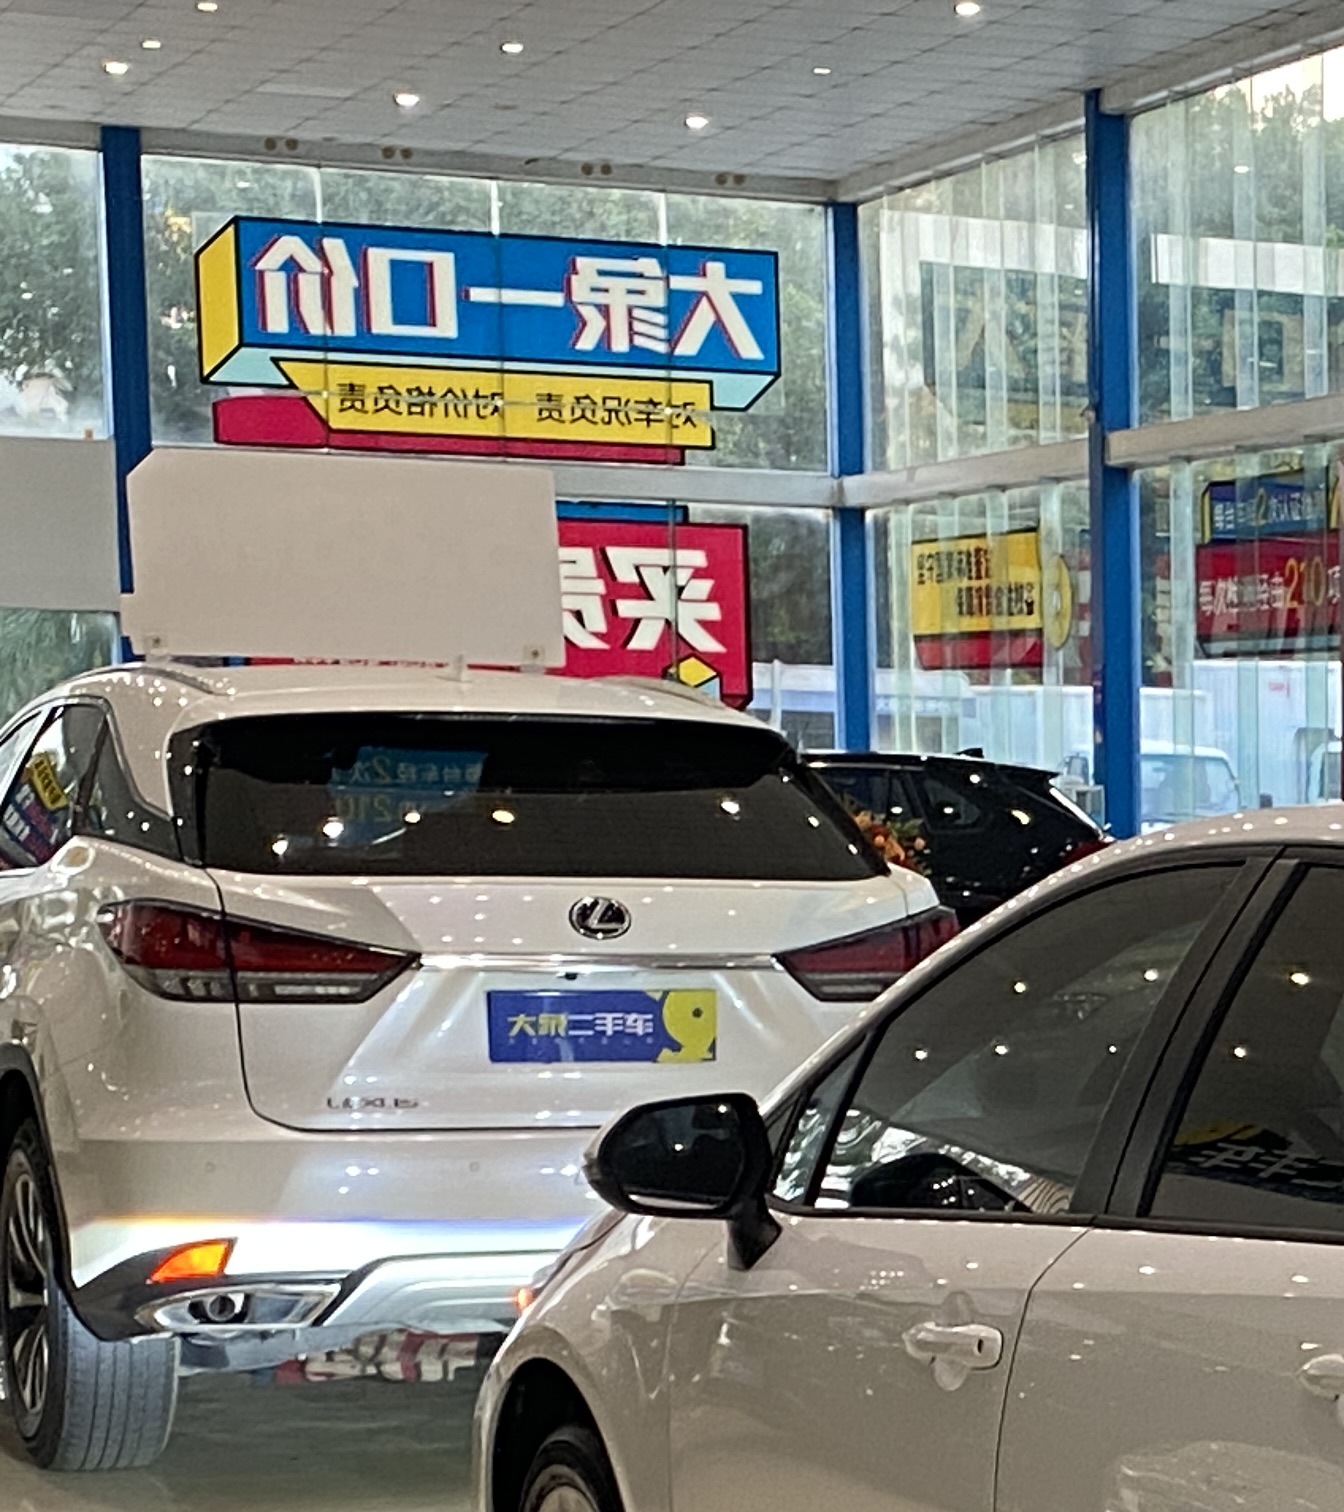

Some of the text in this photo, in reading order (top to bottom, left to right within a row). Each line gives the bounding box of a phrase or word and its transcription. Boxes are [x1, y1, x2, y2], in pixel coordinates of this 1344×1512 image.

[507, 1013, 654, 1037] 大象二手车
